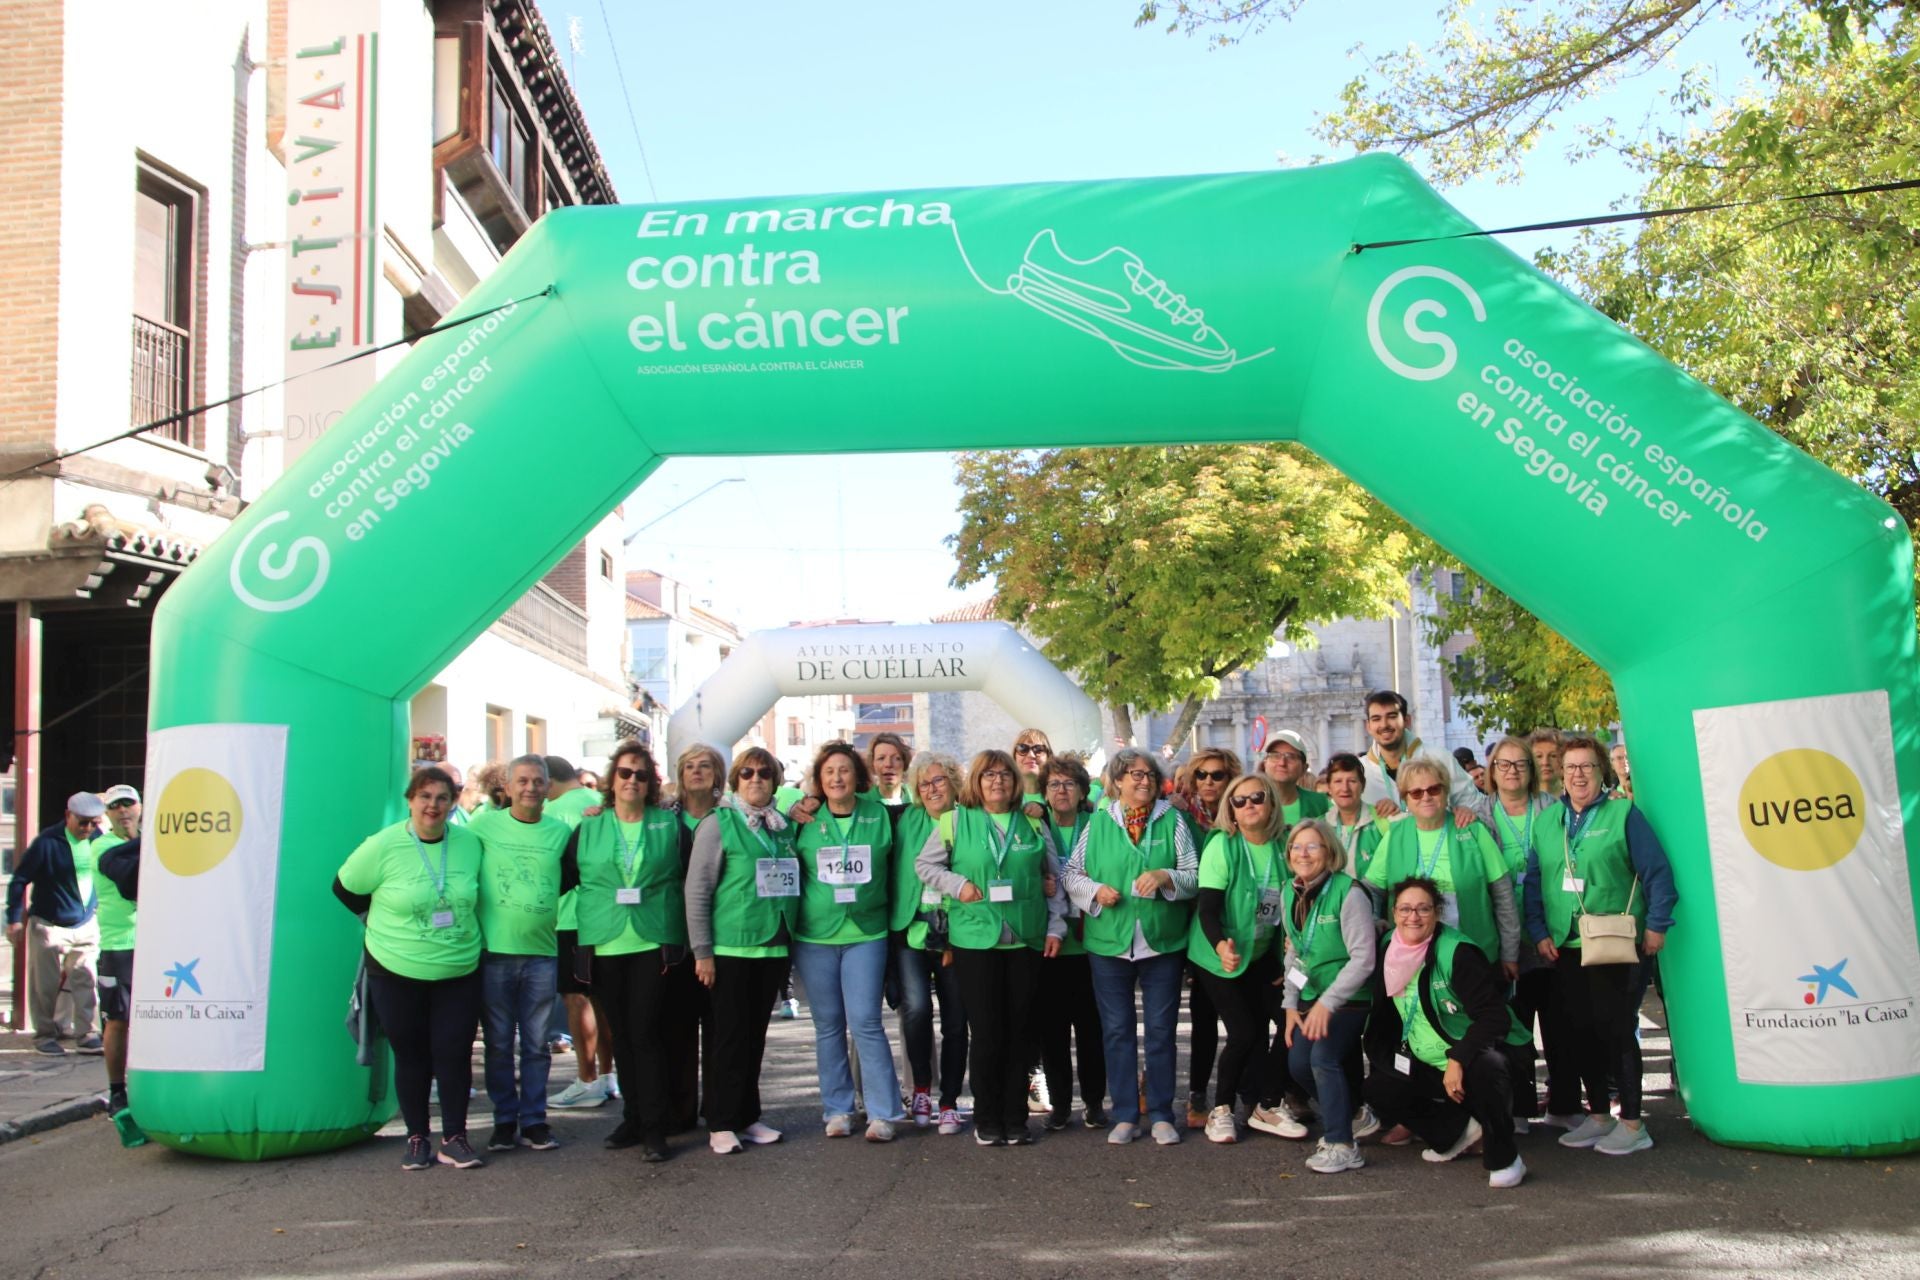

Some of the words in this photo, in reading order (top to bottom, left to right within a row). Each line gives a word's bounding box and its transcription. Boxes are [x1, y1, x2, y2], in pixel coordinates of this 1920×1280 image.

[636, 210, 709, 239] En
[723, 199, 953, 235] marcha
[626, 243, 822, 291] contra
[627, 300, 687, 353] el
[698, 298, 909, 352] cáncer
[637, 362, 700, 375] ASOCIACIÓN
[702, 361, 758, 373] ESPAÑOLA
[759, 360, 803, 372] CONTRA
[805, 360, 818, 370] EL
[820, 358, 865, 370] CÁNCER
[308, 391, 421, 500] asociación
[421, 298, 519, 392] española
[324, 450, 397, 519] contra
[395, 424, 421, 453] el
[418, 355, 493, 431] cáncer
[1457, 391, 1498, 429] en
[1495, 417, 1610, 517] Segovia
[1480, 364, 1569, 439] contra
[1568, 430, 1600, 459] el
[1596, 452, 1693, 528] cáncer
[1503, 337, 1642, 449] asociación
[1644, 443, 1769, 543] española
[345, 507, 382, 541] en
[374, 420, 475, 512] Segovia
[797, 641, 964, 657] AYUNTAMIENTO
[797, 660, 835, 681] DE
[842, 656, 968, 681] CUÉLLAR
[158, 810, 232, 835] uvesa
[1748, 793, 1856, 827] uvesa
[826, 860, 863, 874] 1240
[134, 1004, 183, 1020] Fundación
[1744, 1011, 1837, 1029] Fundación
